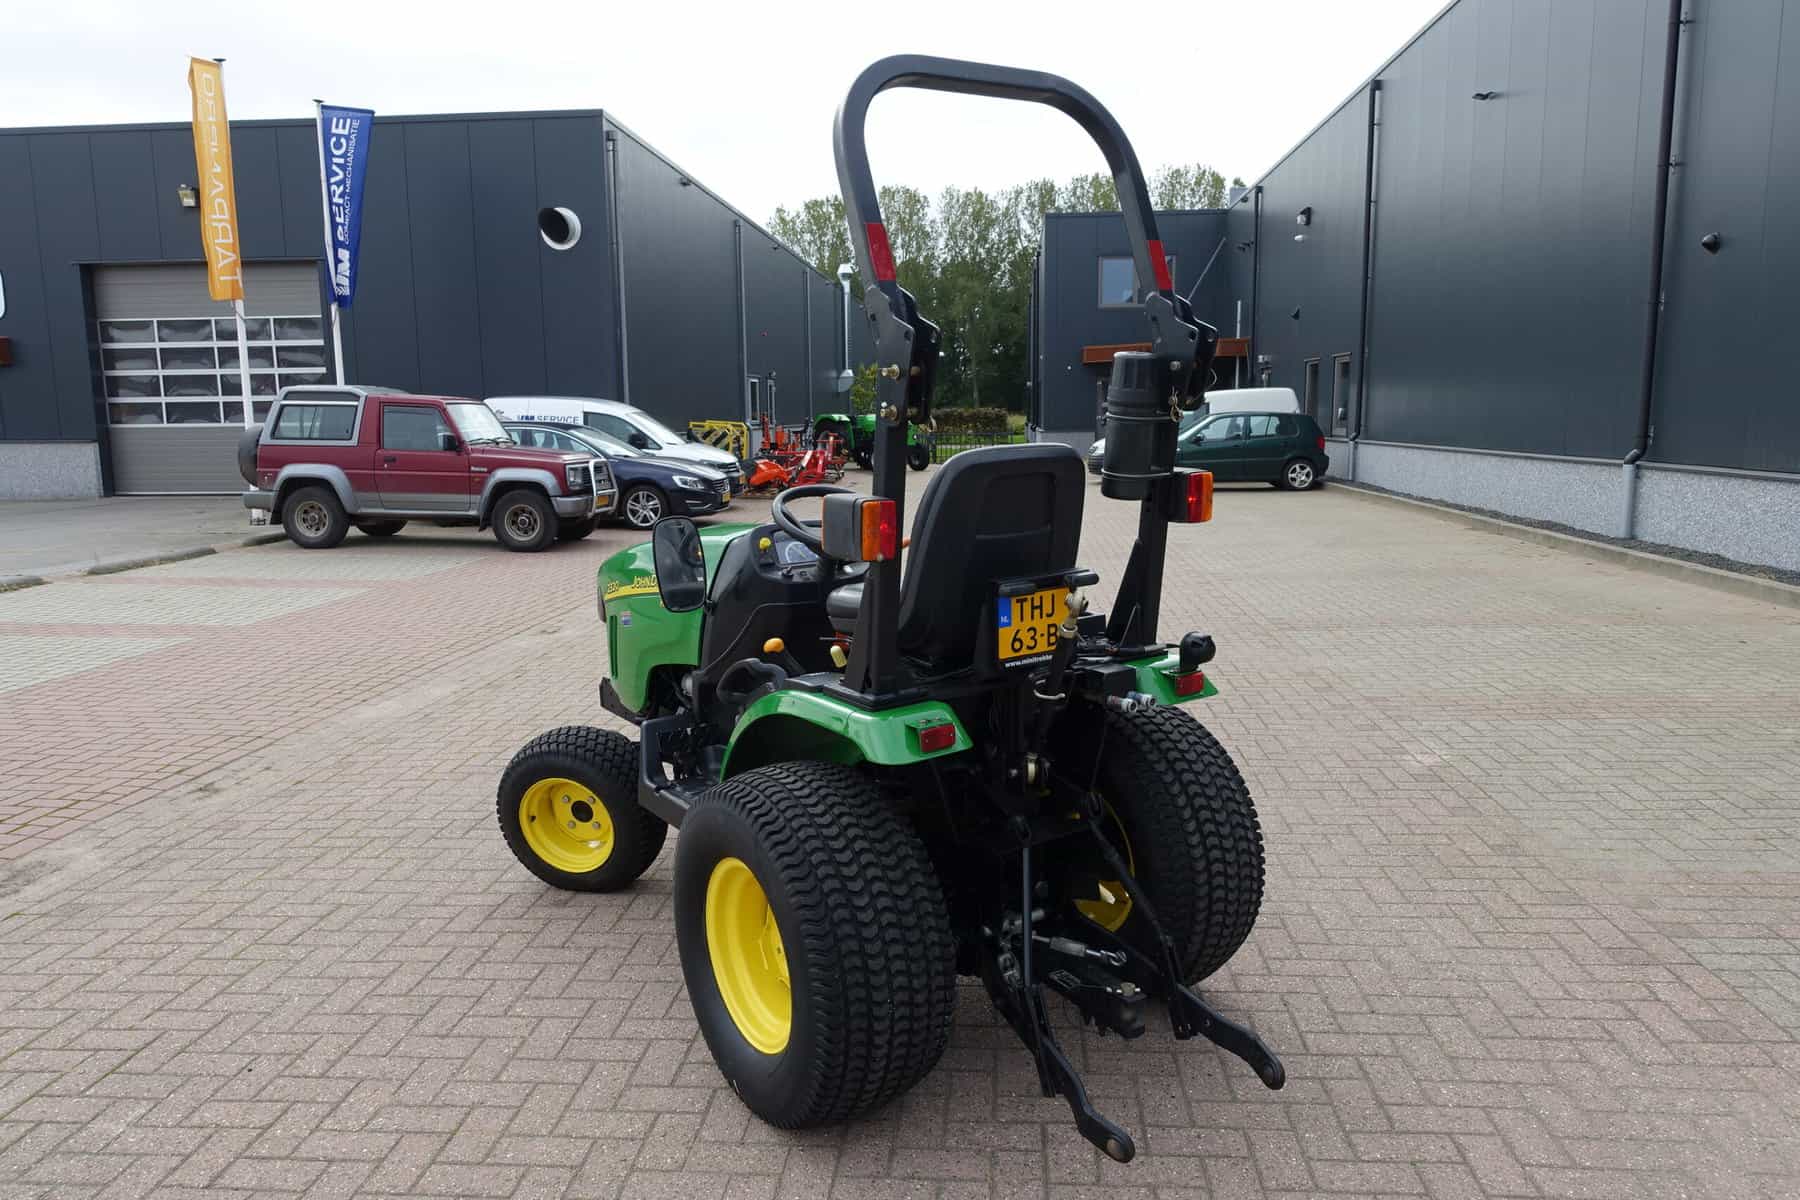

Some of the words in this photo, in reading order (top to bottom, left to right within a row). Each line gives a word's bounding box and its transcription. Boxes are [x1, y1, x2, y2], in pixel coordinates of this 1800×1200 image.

[330, 116, 351, 241] SERVICE
[345, 119, 360, 193] MECHANISATIE
[343, 195, 352, 246] COMPACT
[1015, 592, 1055, 623] THJ
[1011, 623, 1058, 653] 63-B
